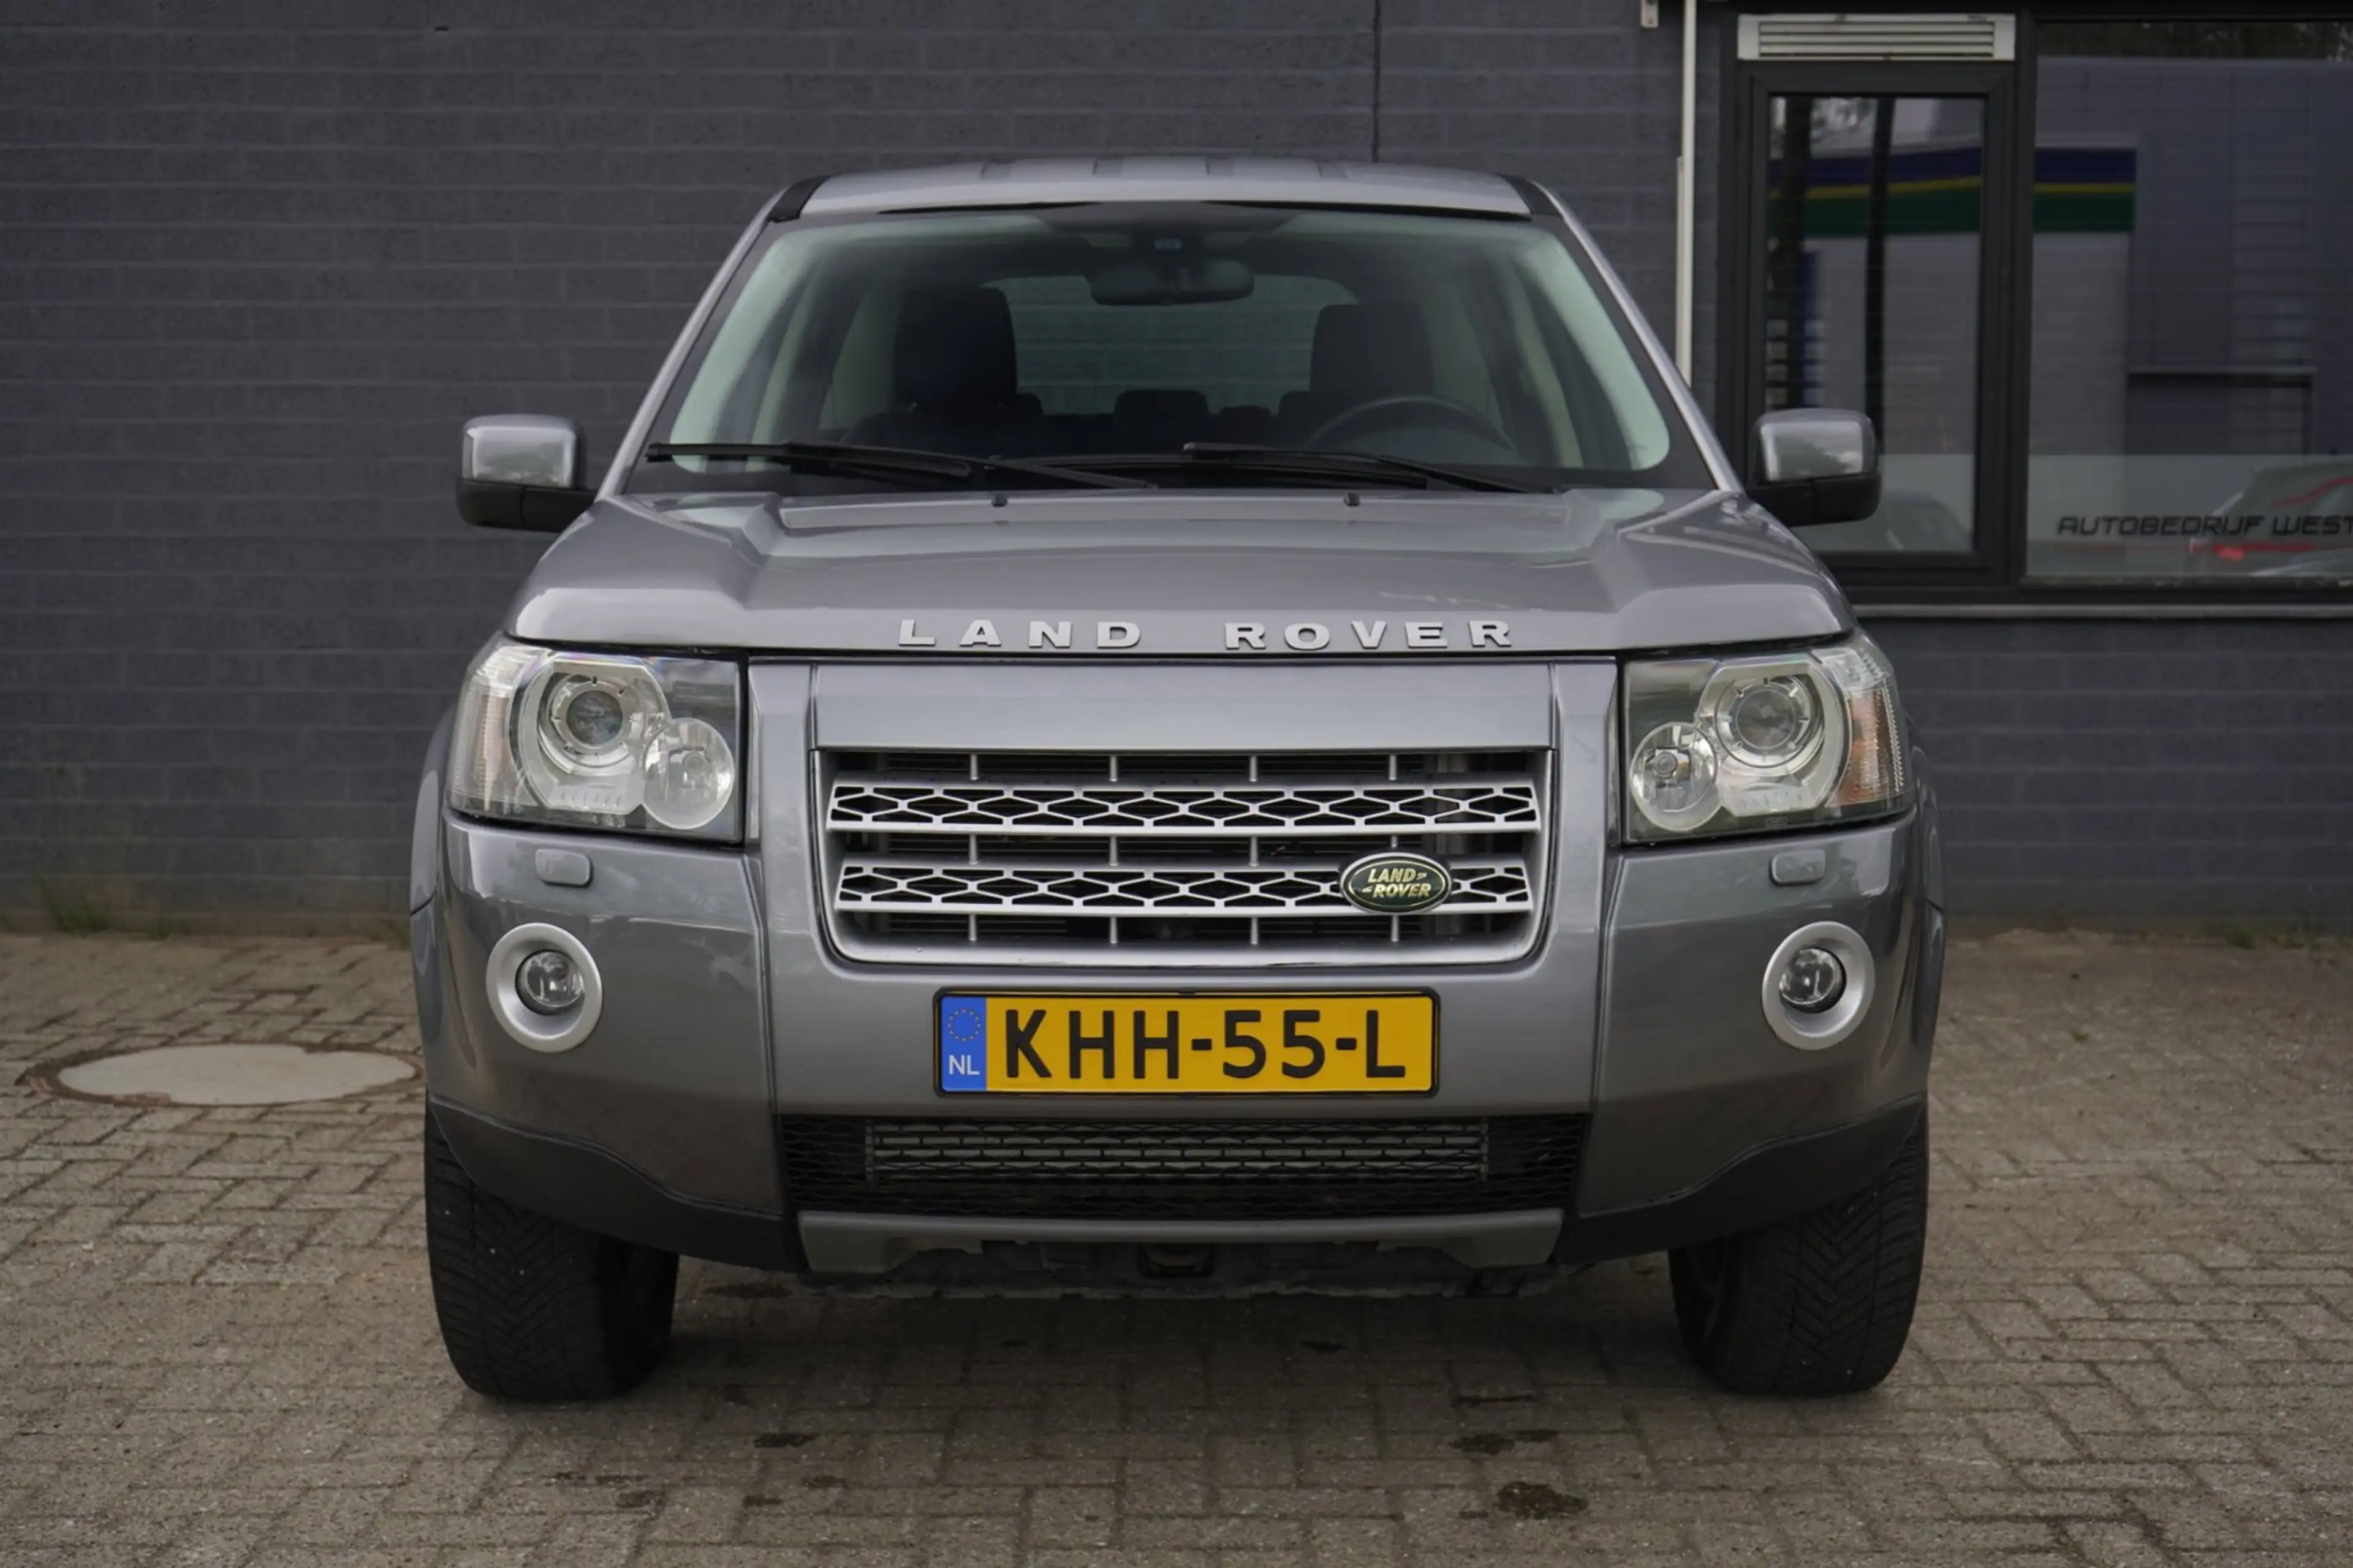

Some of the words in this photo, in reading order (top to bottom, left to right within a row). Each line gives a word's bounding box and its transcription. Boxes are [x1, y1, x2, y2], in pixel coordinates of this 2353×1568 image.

[2057, 515, 2265, 536] AUTOBEDRIJF
[898, 618, 1142, 648] LAND
[1226, 619, 1513, 650] ROVER
[1367, 868, 1416, 883] LAND
[1372, 883, 1432, 898] ROVER
[1005, 1009, 1406, 1078] KHH-55-L
[949, 1053, 980, 1075] NL
